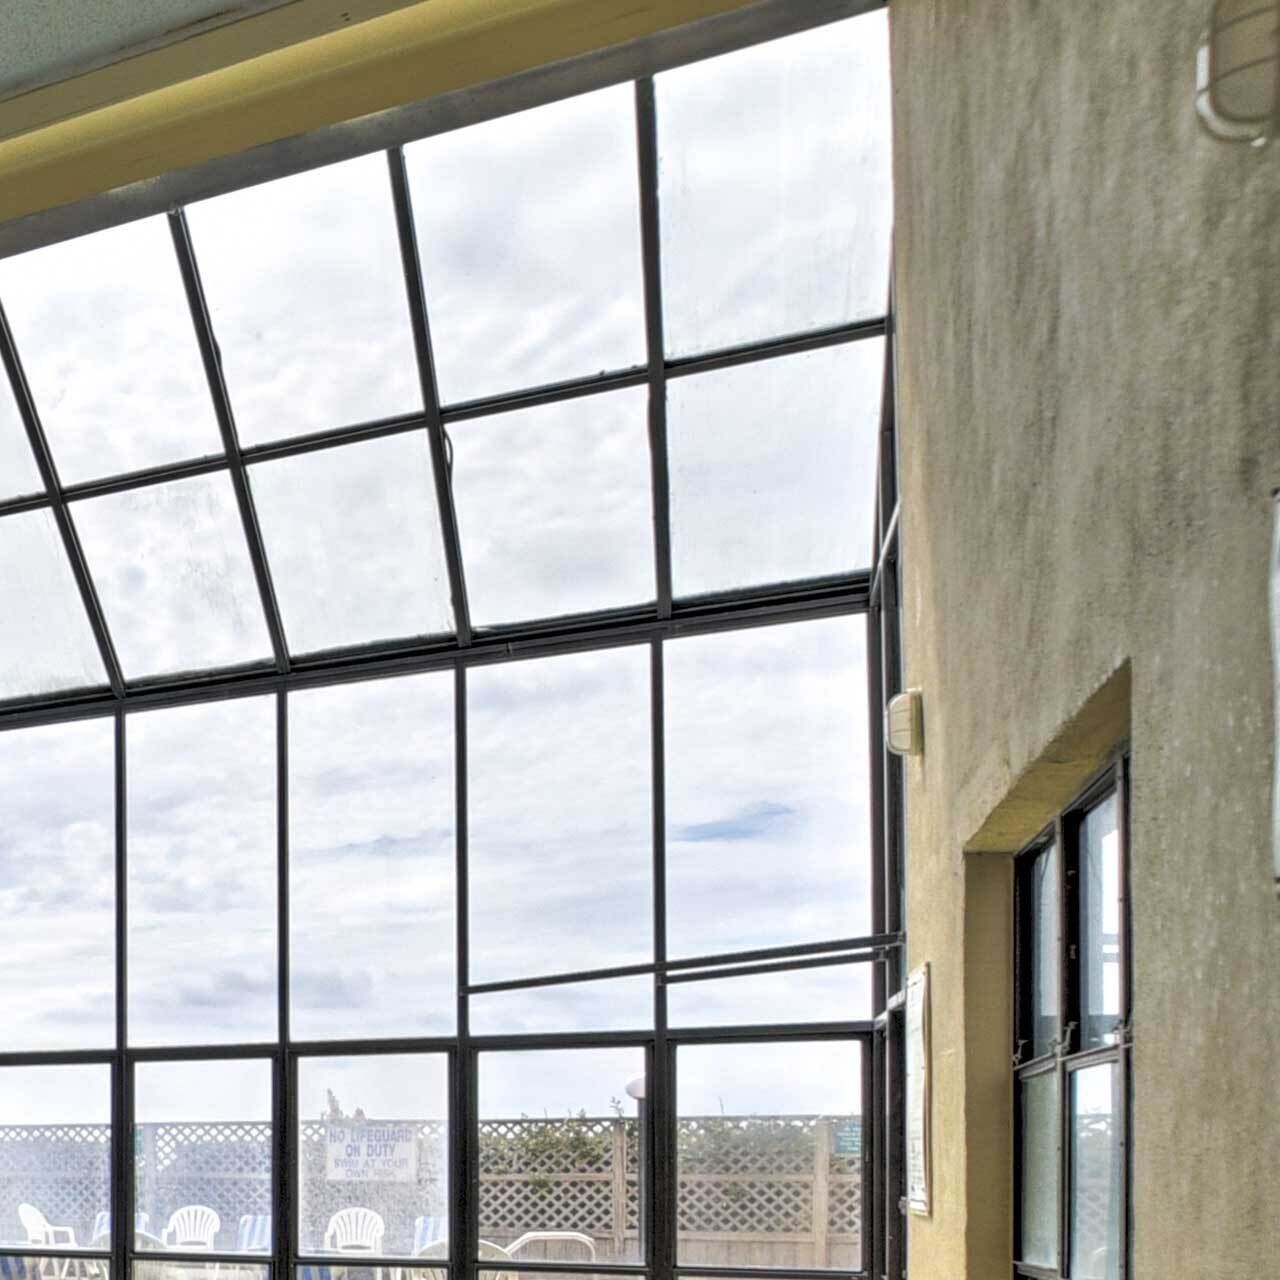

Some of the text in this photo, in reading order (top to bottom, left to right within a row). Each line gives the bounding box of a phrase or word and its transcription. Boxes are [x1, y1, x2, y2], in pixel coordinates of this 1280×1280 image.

[329, 1128, 413, 1143] NO LIFEGUARD
[345, 1144, 396, 1157] ON DUTY
